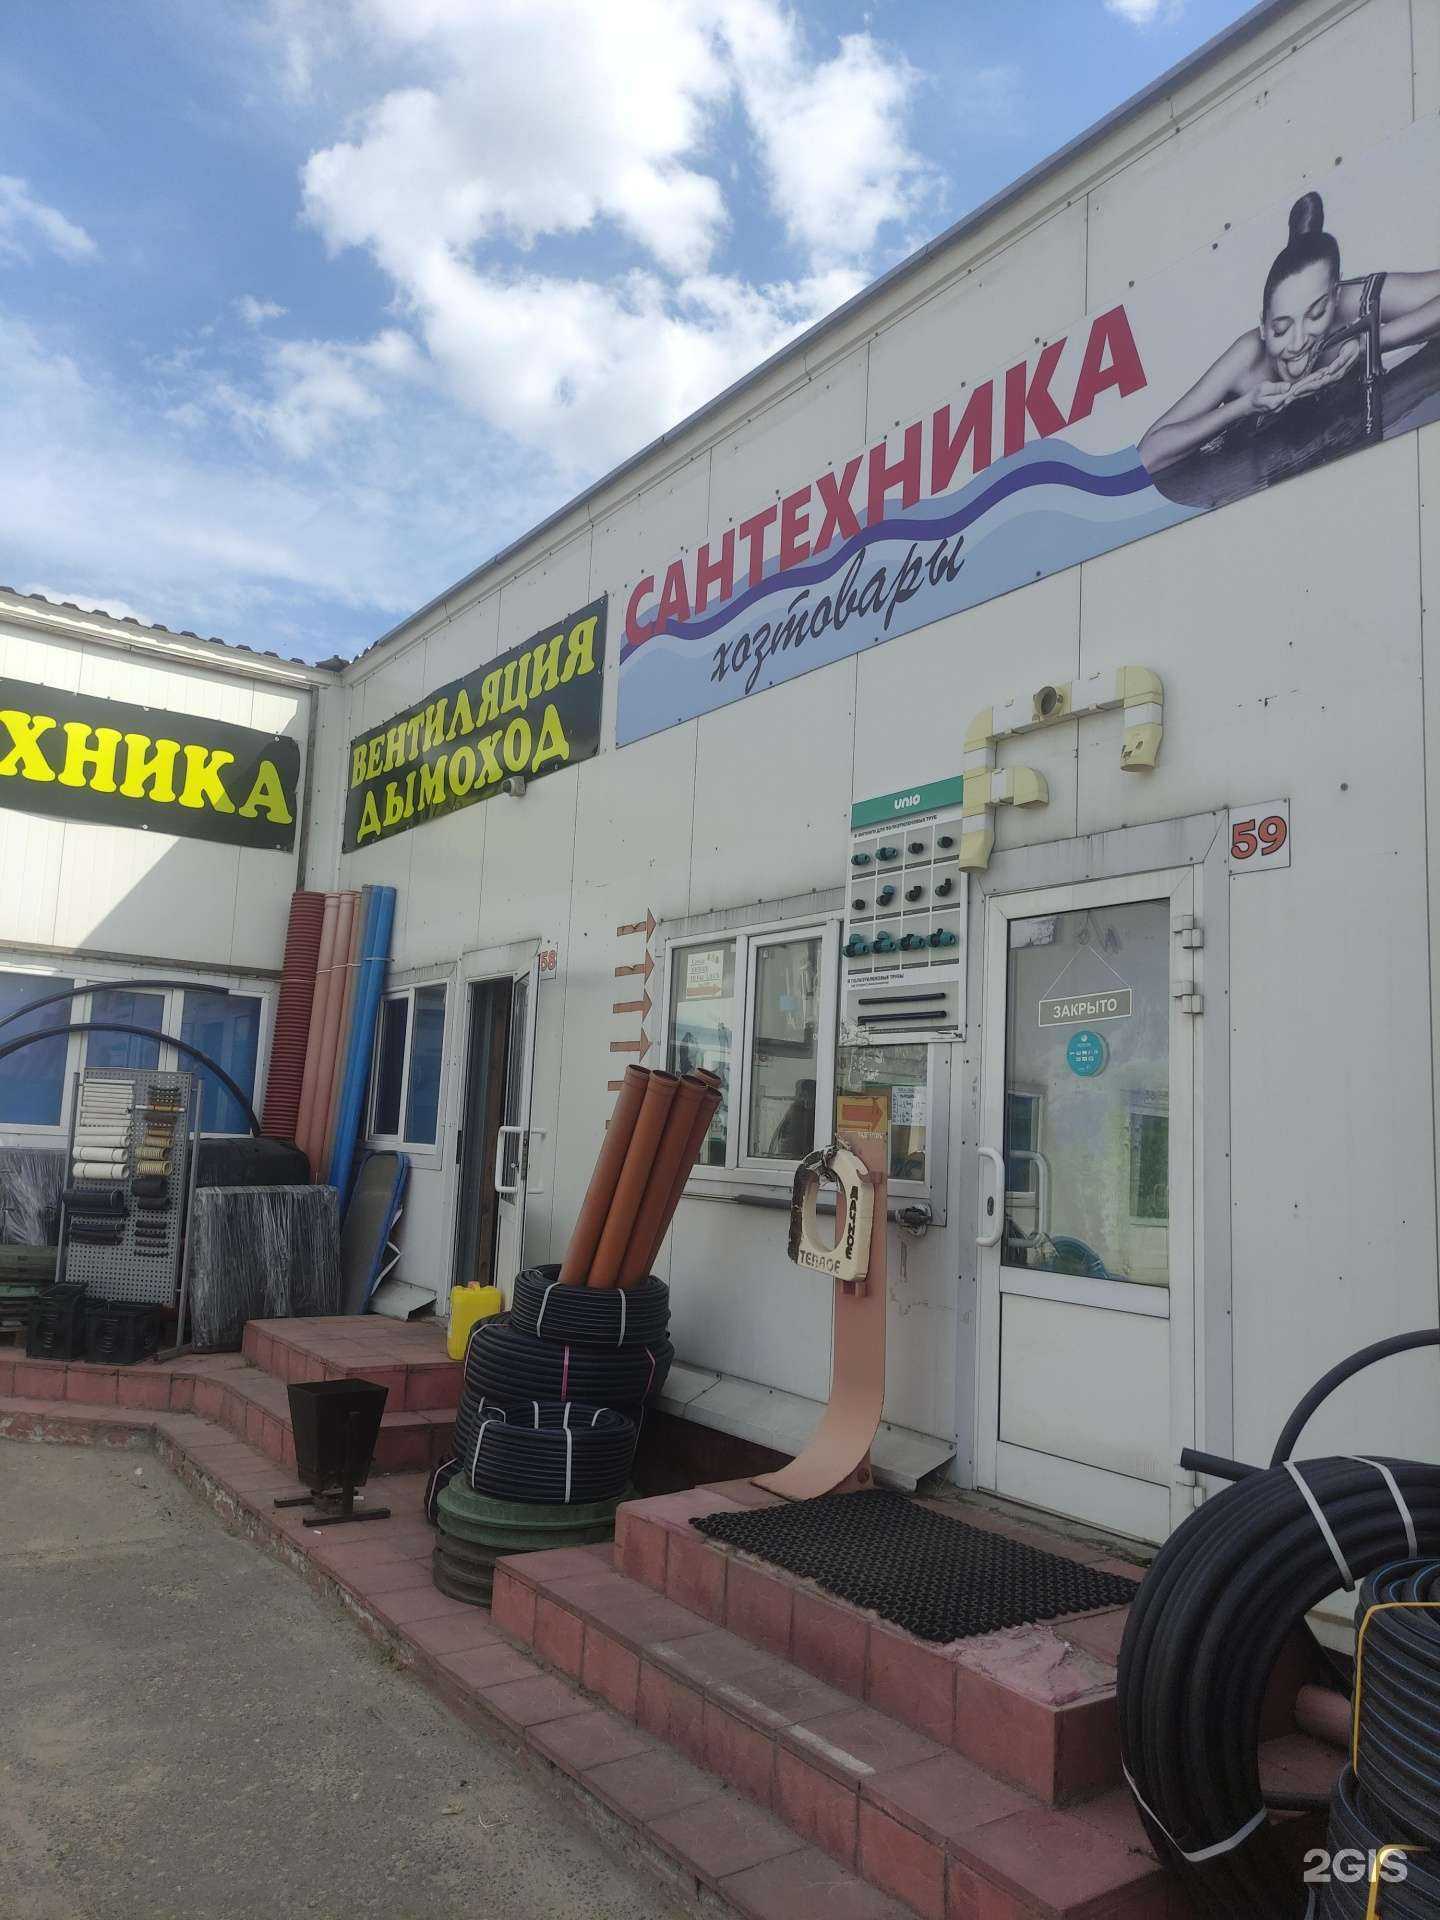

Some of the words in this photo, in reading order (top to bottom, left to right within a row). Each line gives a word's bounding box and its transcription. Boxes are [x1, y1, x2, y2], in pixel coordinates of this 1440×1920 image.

[625, 304, 1148, 647] САНТЕХНИКА
[710, 536, 966, 694] хозтовары
[350, 615, 598, 790] ВЕНТИЛЯЦИЯ
[357, 703, 572, 844] ДЫМОХОД
[1231, 815, 1287, 859] 59
[1053, 998, 1118, 1018] ЗАКРЫТО
